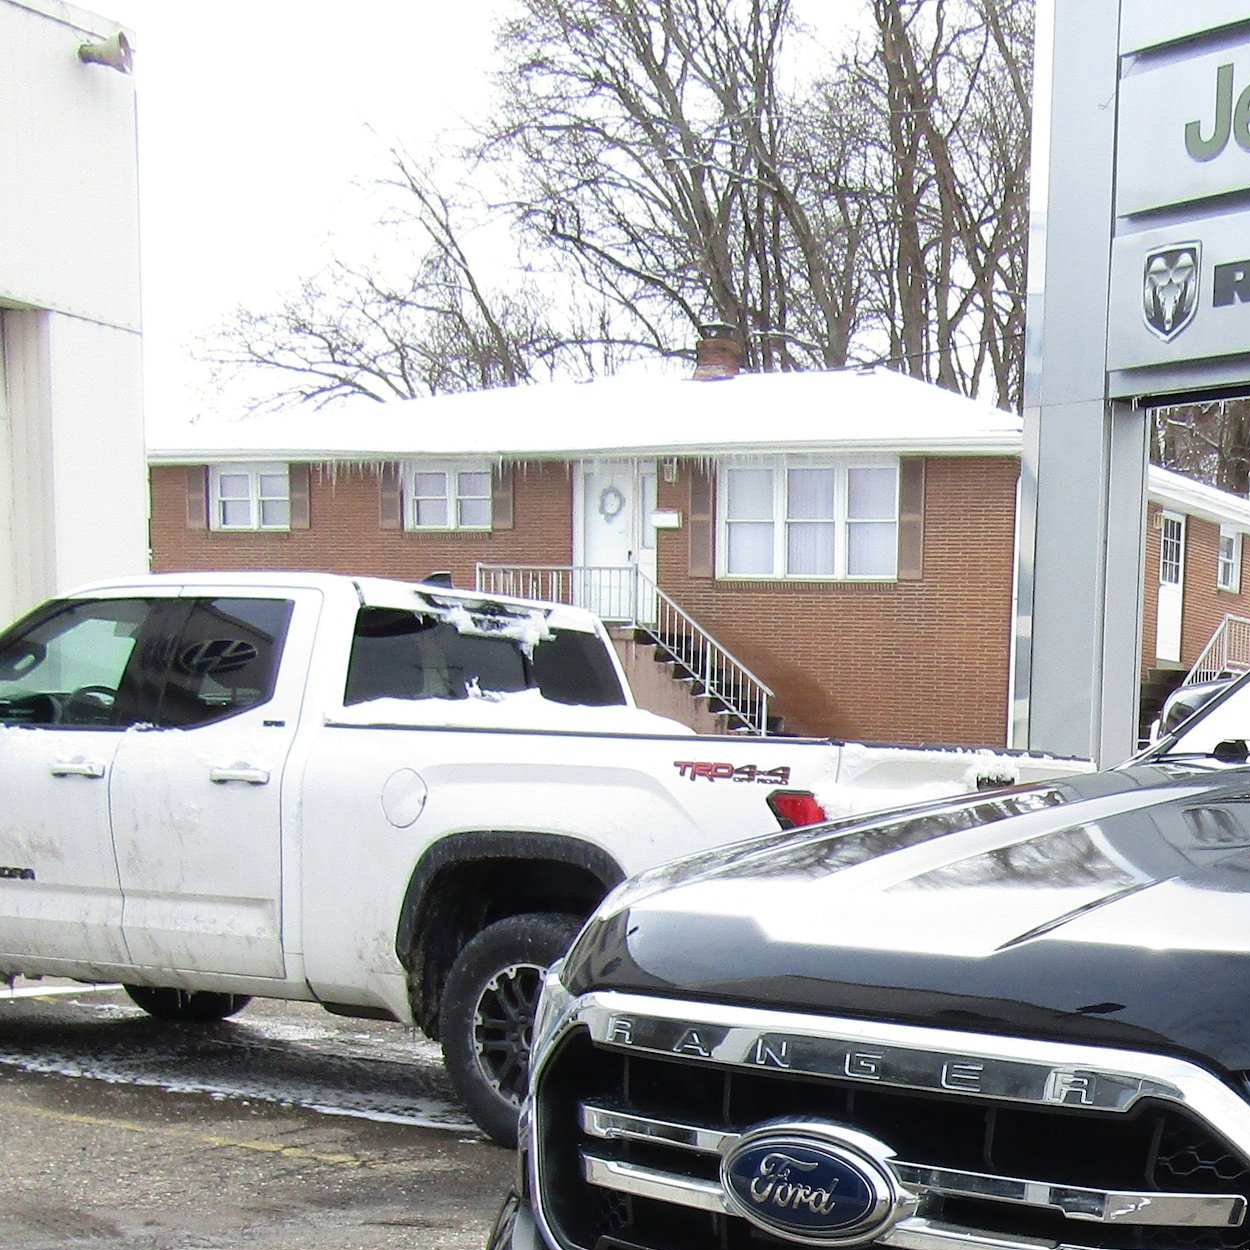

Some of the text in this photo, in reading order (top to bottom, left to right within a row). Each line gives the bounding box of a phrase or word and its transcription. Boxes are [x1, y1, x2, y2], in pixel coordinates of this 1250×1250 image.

[673, 761, 735, 782] TRD
[608, 1012, 1094, 1105] RANGER
[750, 1152, 840, 1216] Ford
